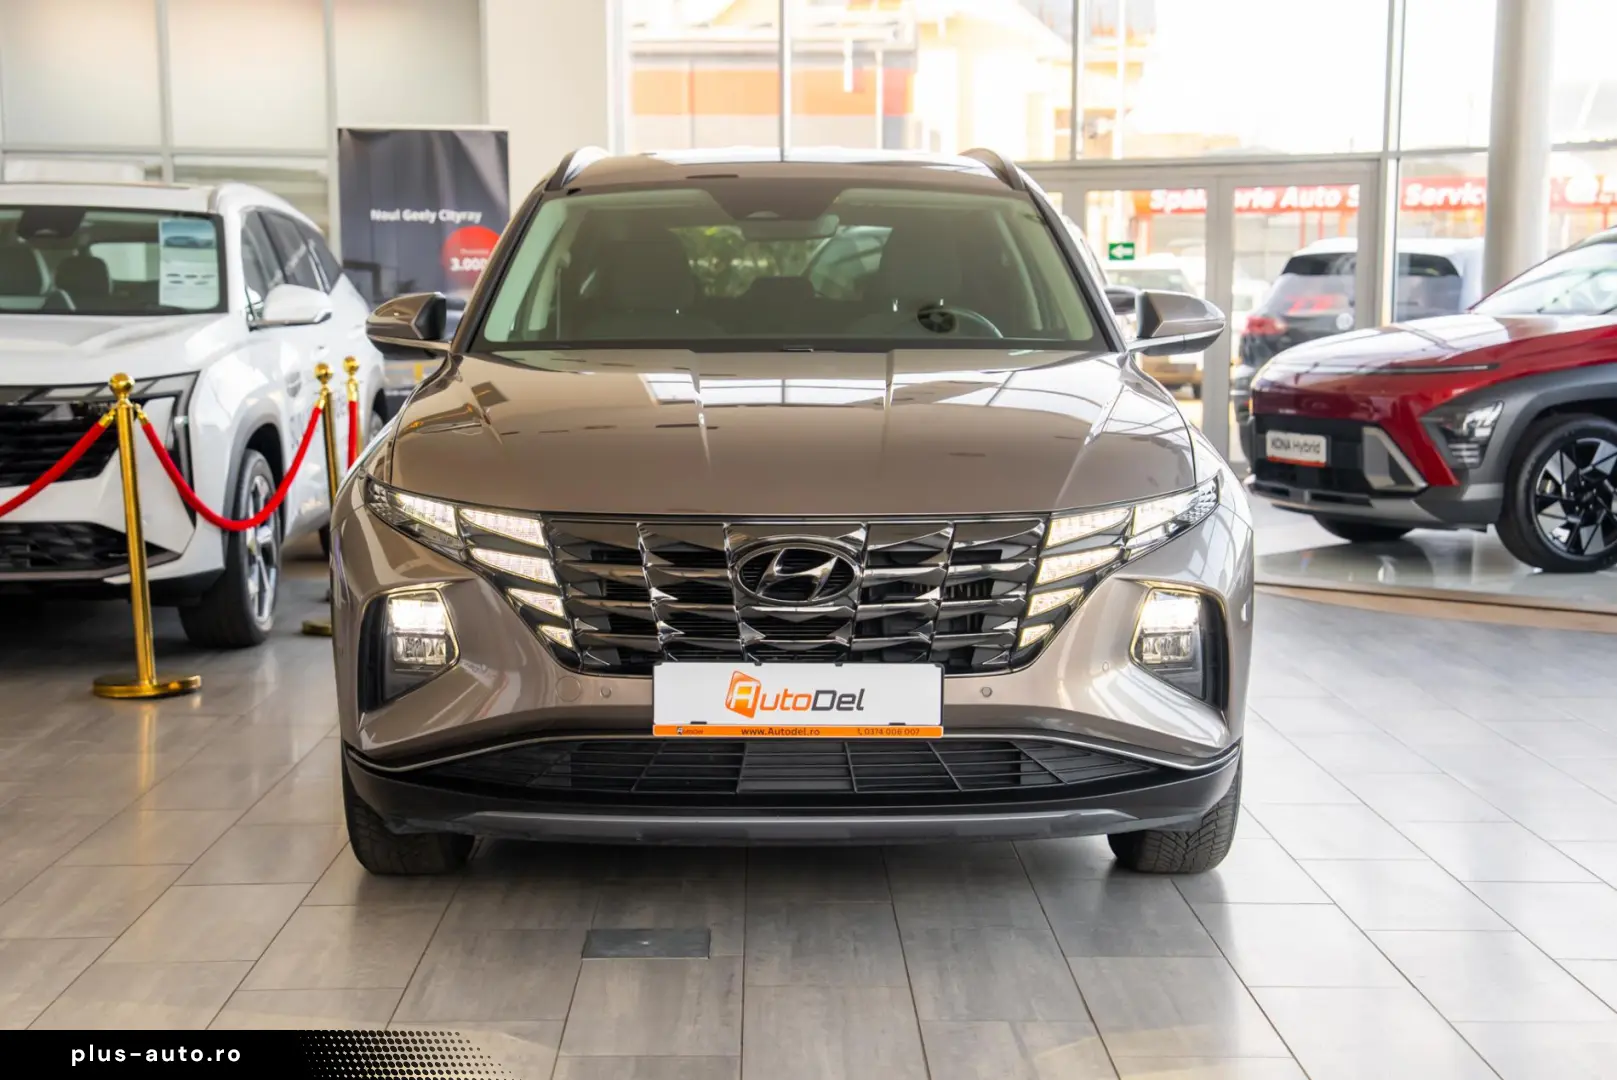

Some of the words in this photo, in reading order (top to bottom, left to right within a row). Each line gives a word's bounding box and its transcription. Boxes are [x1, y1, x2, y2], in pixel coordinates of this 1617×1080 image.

[1280, 185, 1342, 208] Auto
[370, 208, 401, 222] Noul
[402, 208, 437, 224] Geely
[438, 208, 482, 224] Cityray
[1293, 439, 1321, 456] Hybrid
[725, 670, 865, 719] AutoDel
[741, 727, 820, 736] www.Autodel.ro
[864, 727, 883, 736] 0374
[904, 727, 920, 736] 007
